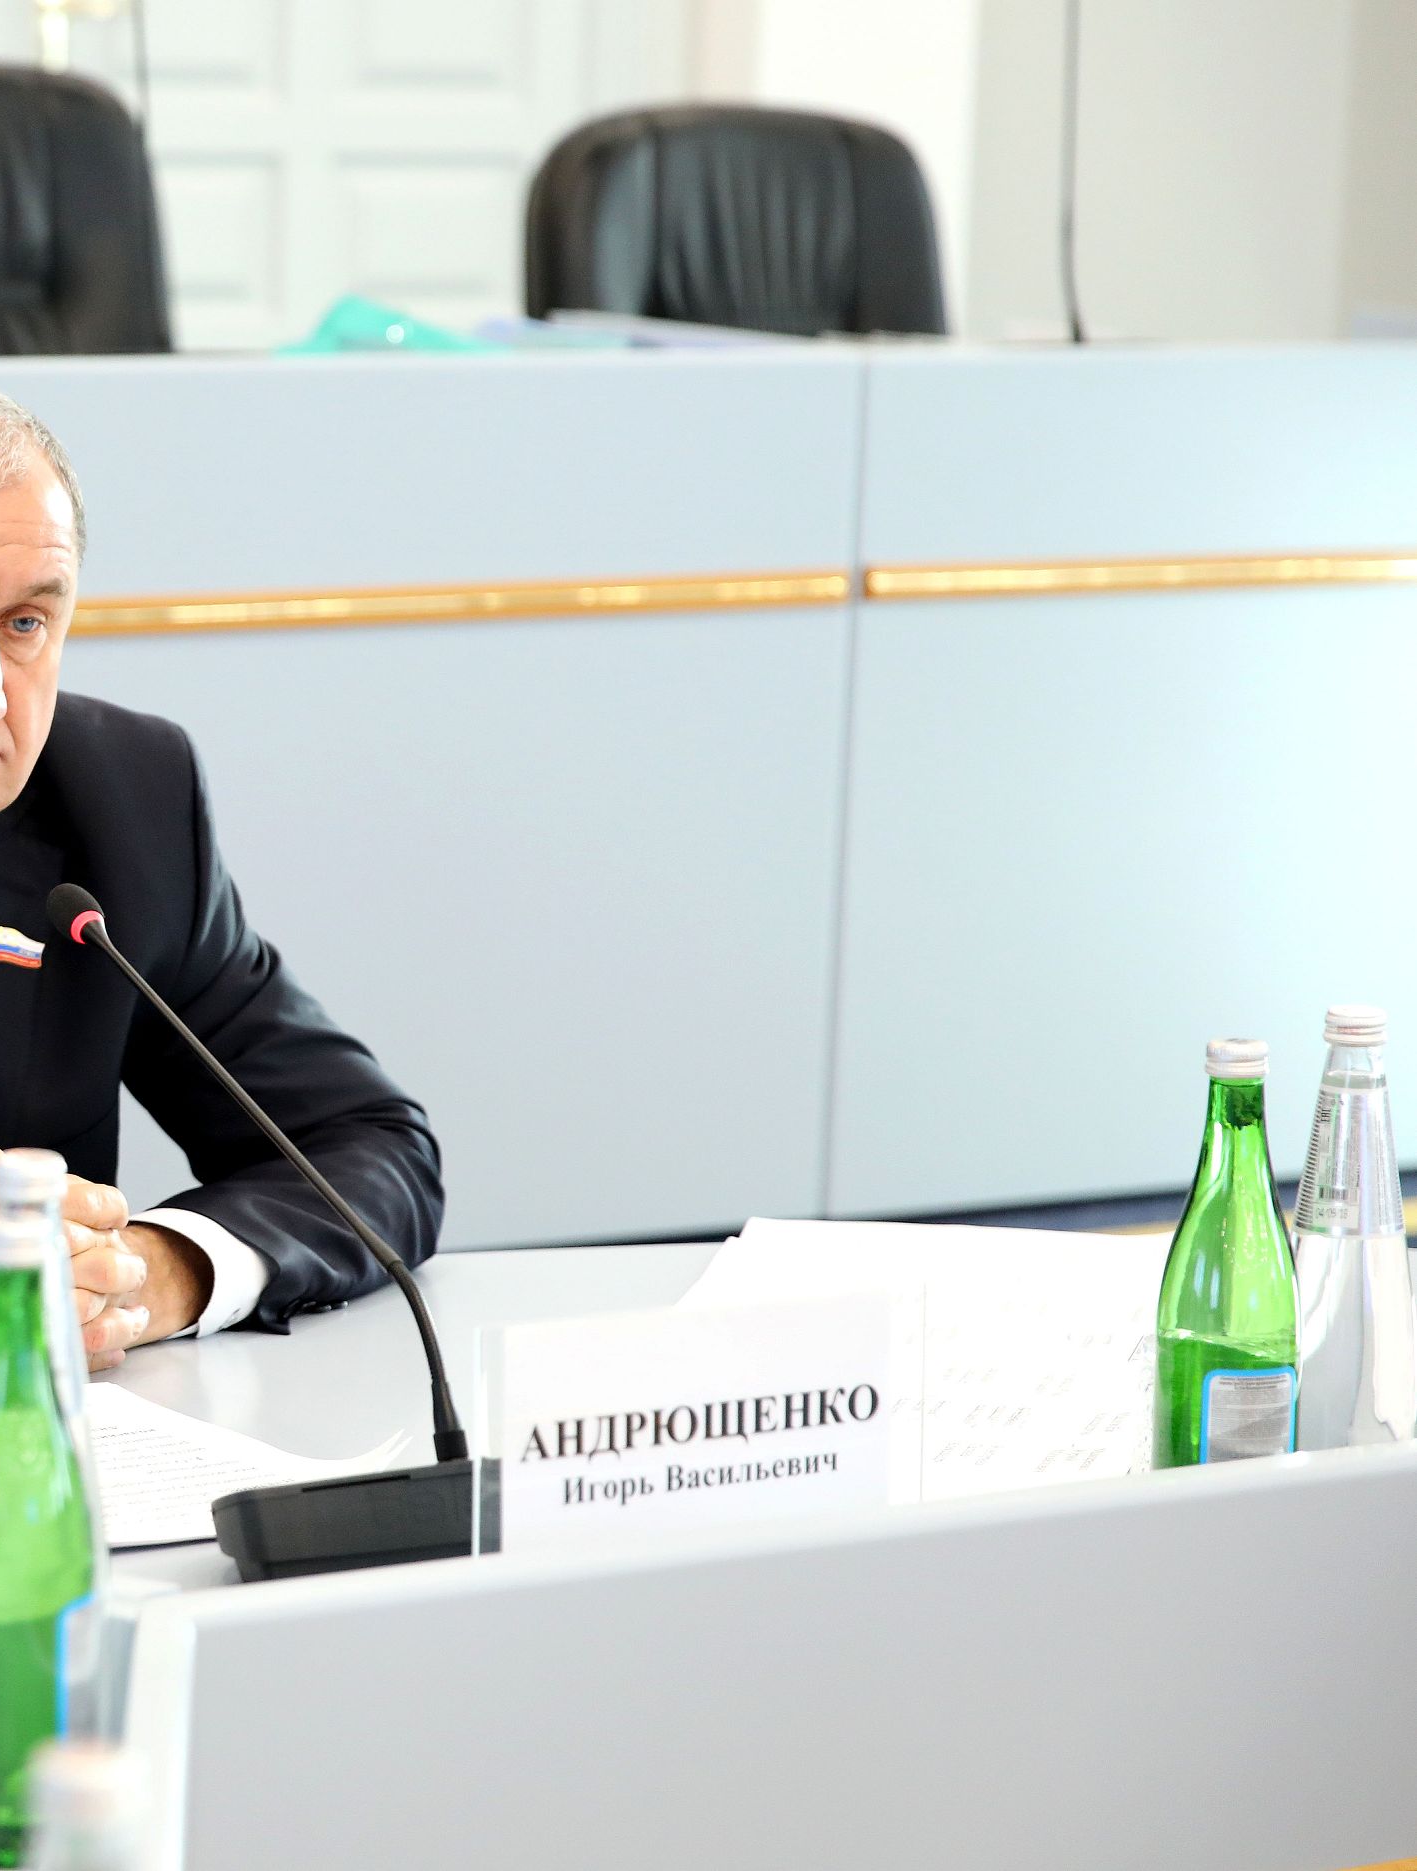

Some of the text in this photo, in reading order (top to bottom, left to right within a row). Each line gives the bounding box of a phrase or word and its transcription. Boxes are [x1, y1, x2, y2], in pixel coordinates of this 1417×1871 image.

[520, 1383, 880, 1463] АНДРЮЩЕНКО
[564, 1452, 838, 1506] Игорь Васильевич
